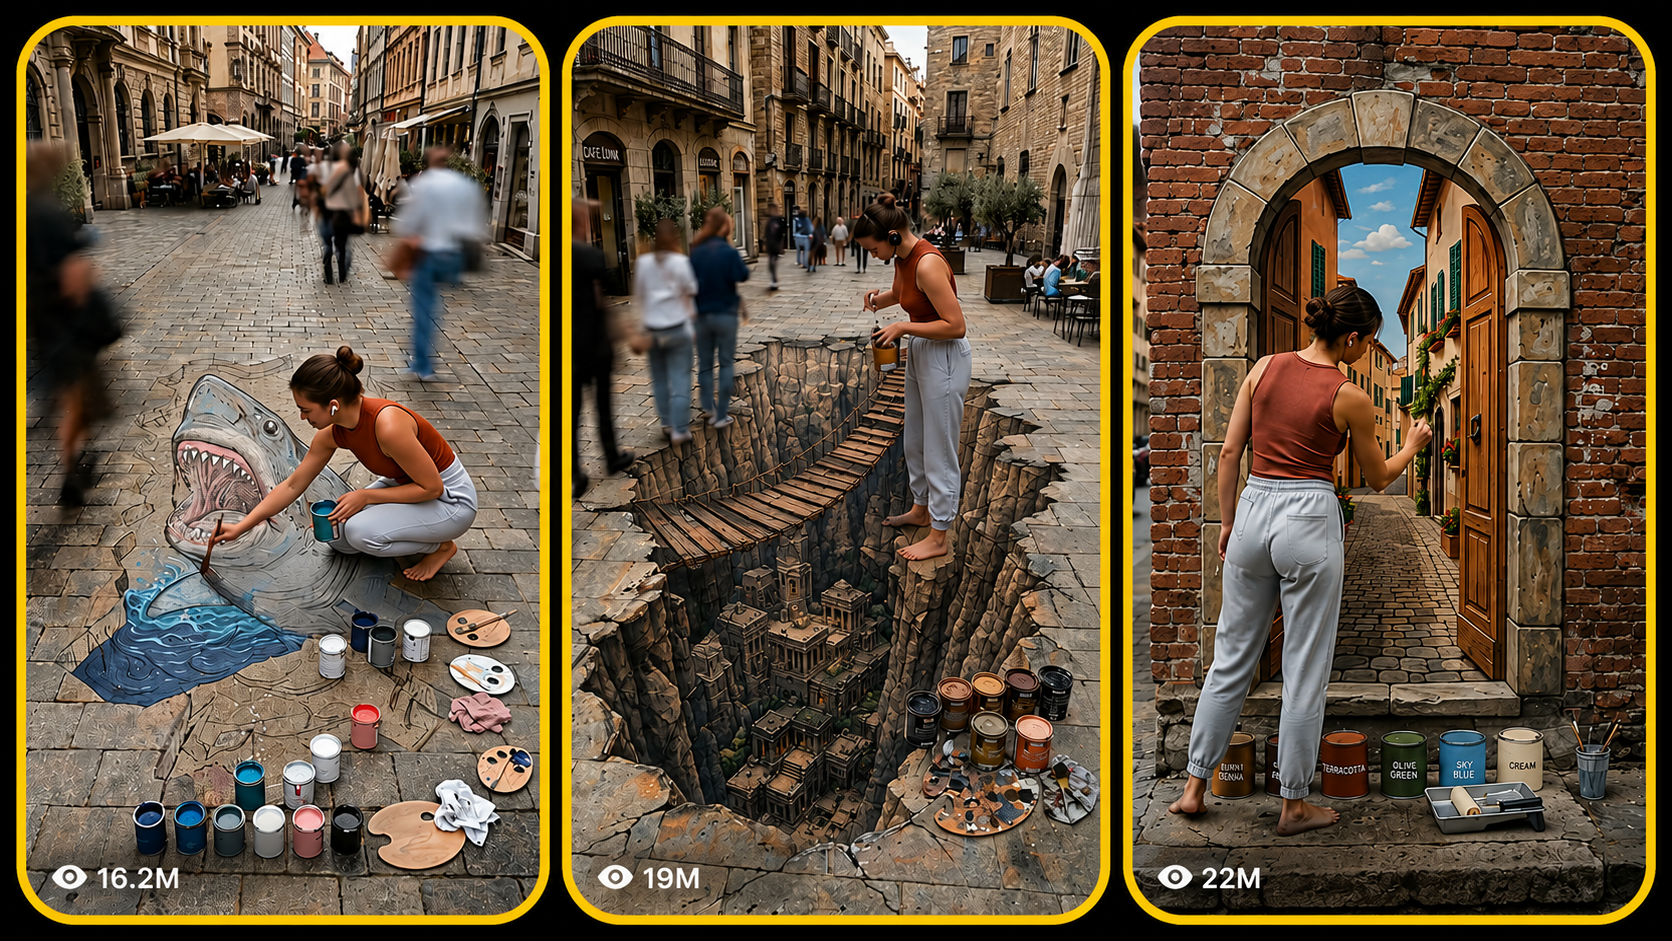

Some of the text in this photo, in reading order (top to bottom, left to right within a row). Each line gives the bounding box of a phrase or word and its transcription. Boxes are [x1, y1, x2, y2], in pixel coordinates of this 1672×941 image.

[1392, 761, 1417, 770] OLIVE
[1456, 760, 1474, 769] SKY
[1508, 761, 1537, 771] CREAM
[1390, 770, 1418, 780] GREEN
[1453, 770, 1475, 779] BLUE
